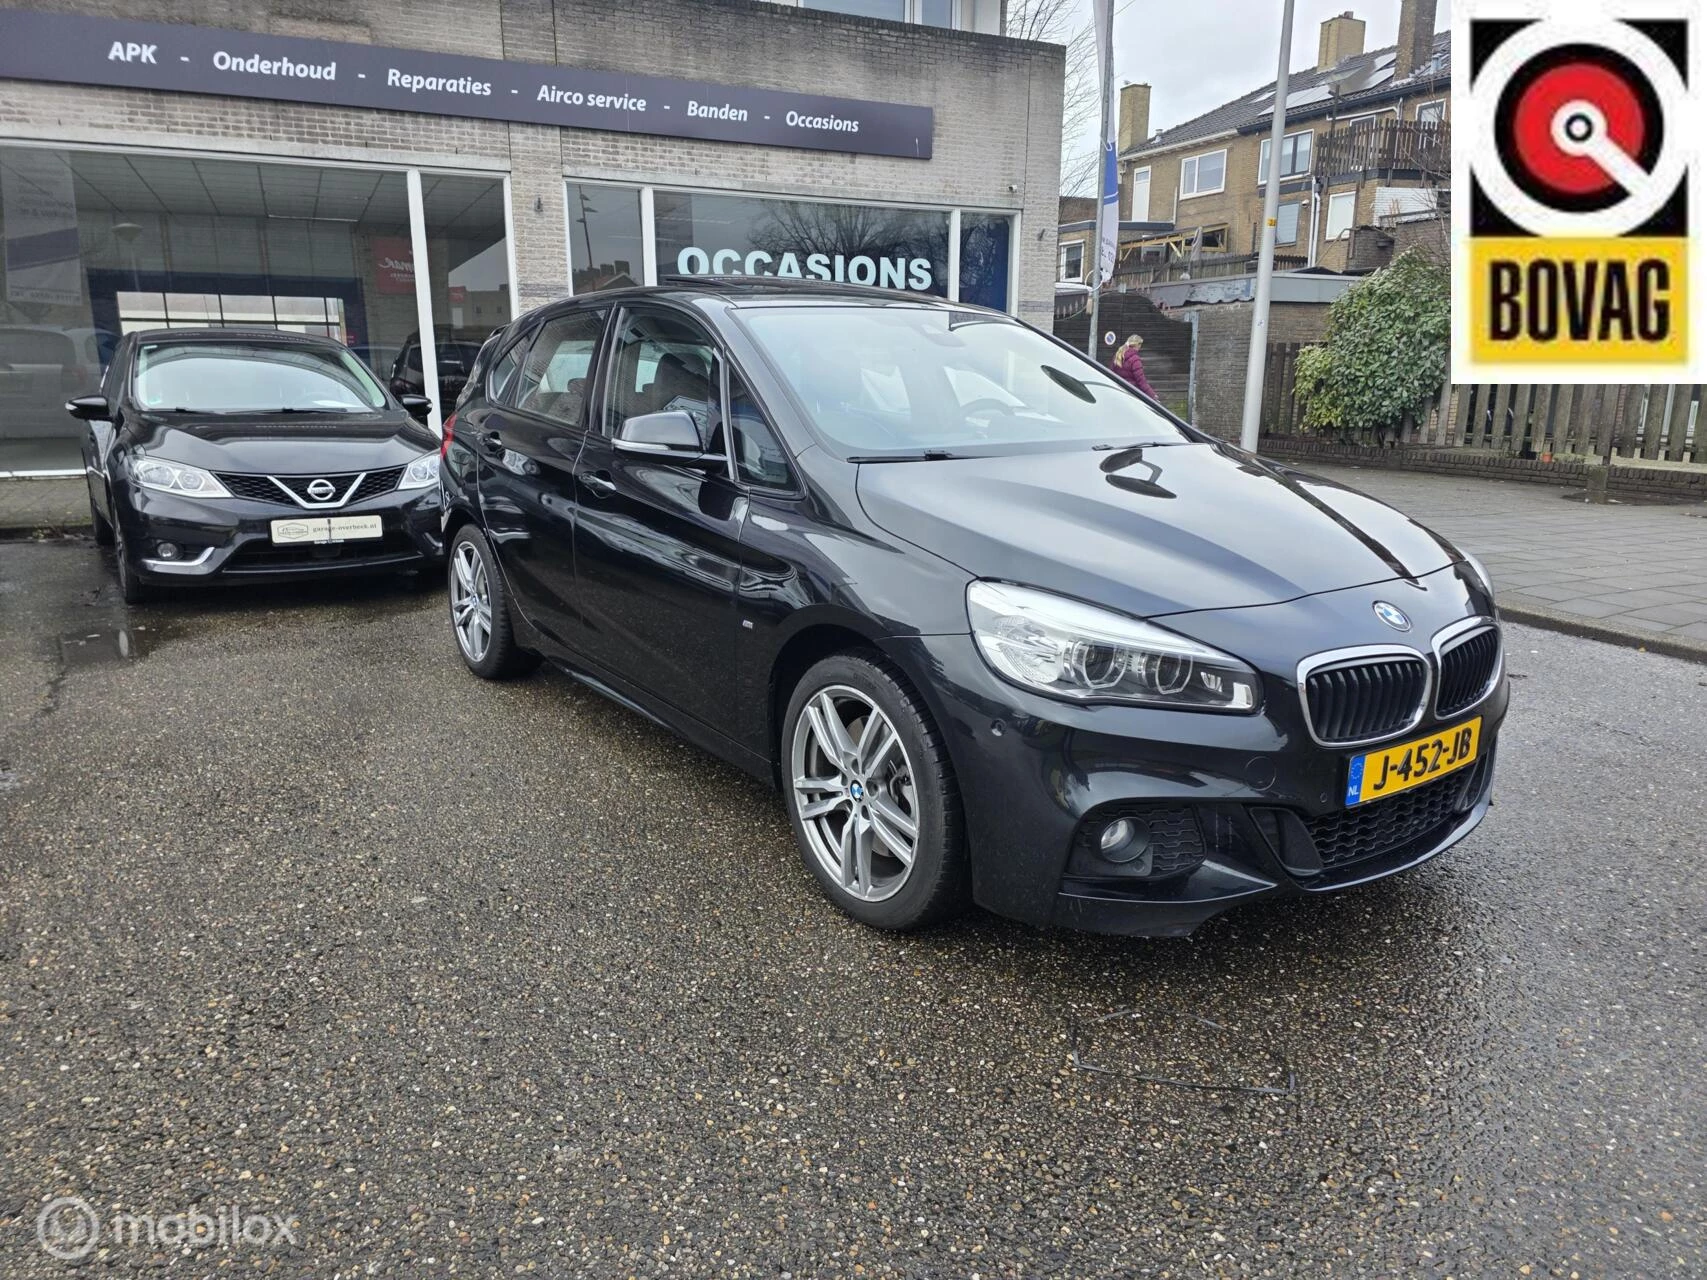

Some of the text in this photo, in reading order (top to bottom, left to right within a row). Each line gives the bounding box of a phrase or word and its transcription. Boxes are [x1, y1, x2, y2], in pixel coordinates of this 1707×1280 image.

[108, 41, 157, 64] APK
[213, 51, 336, 80] Onderhoud
[387, 68, 492, 96] Reparaties
[536, 85, 584, 105] Airco
[587, 93, 647, 112] service
[687, 100, 748, 122] Banden
[785, 110, 859, 133] Occasions
[677, 246, 932, 291] OCCASIONS
[1373, 727, 1473, 790] J-452-JB
[1348, 785, 1359, 797] NL
